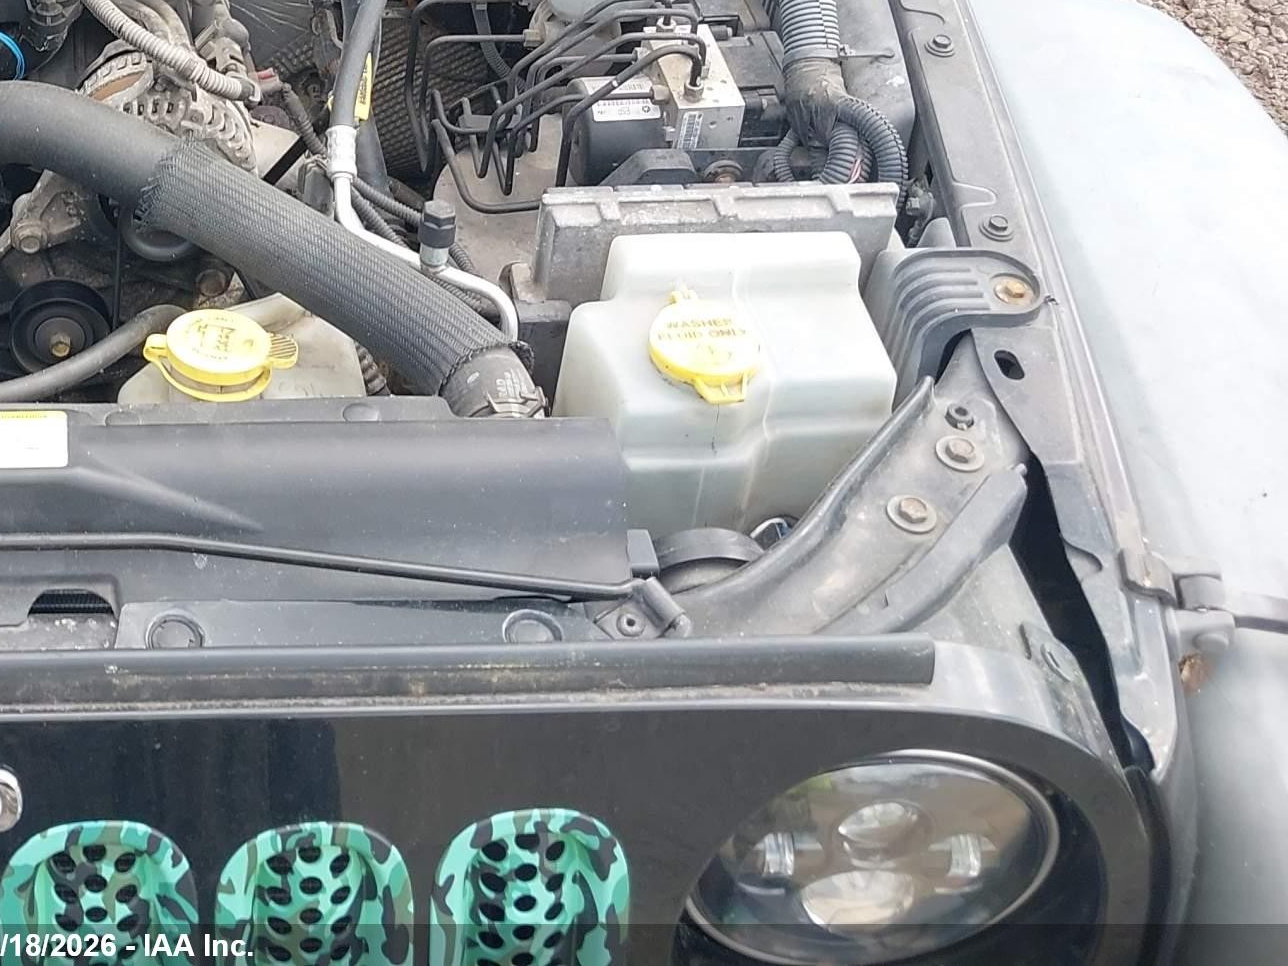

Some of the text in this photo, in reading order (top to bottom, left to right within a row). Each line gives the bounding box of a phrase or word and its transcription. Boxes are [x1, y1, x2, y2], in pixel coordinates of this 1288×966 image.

[665, 318, 732, 329] WASHER
[657, 327, 746, 341] FLUID ONLY
